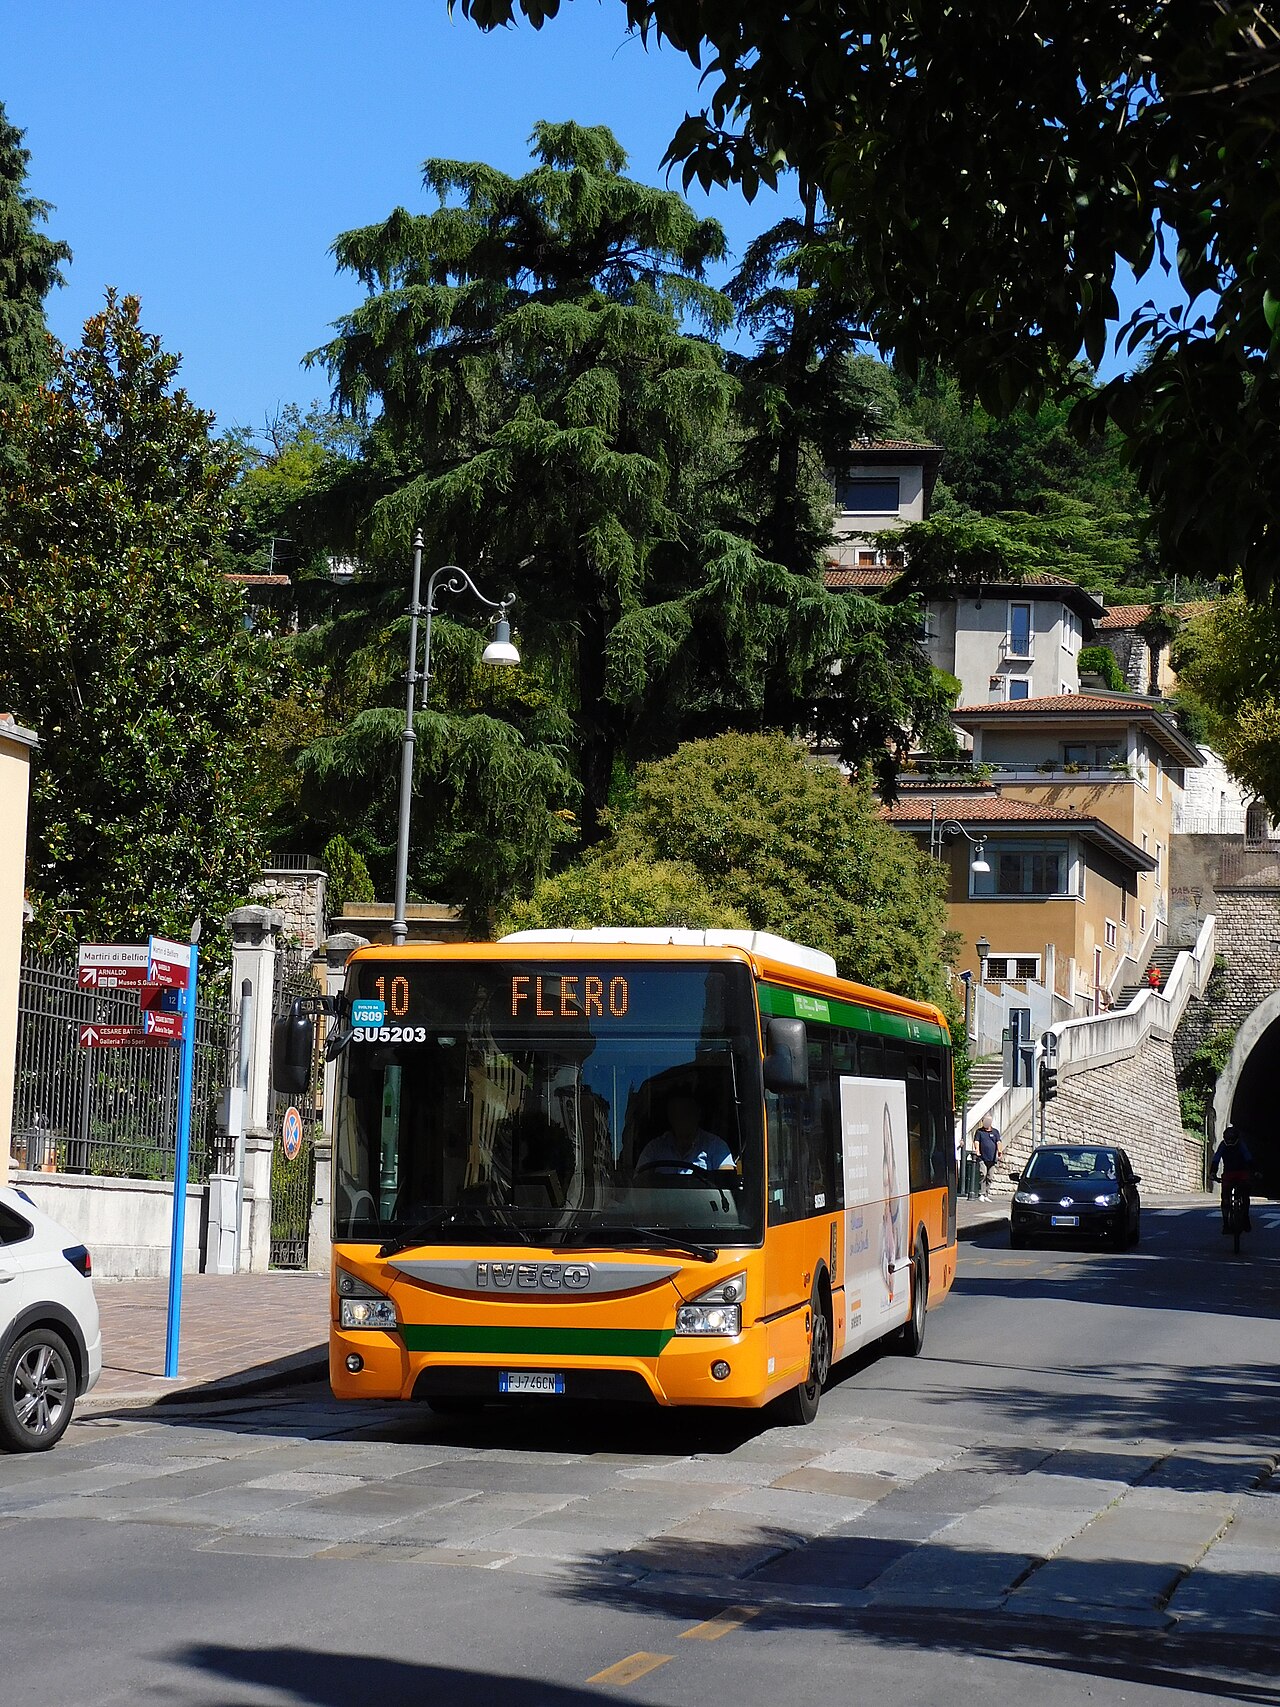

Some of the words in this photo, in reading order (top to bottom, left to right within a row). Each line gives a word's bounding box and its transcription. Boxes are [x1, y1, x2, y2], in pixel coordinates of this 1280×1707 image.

[121, 953, 147, 961] Belfior
[168, 996, 177, 1005] 12
[375, 976, 409, 1016] 10
[511, 976, 629, 1016] FLERO
[353, 1011, 383, 1022] VS09
[352, 1027, 427, 1043] SU5203
[476, 1262, 591, 1290] IVECO
